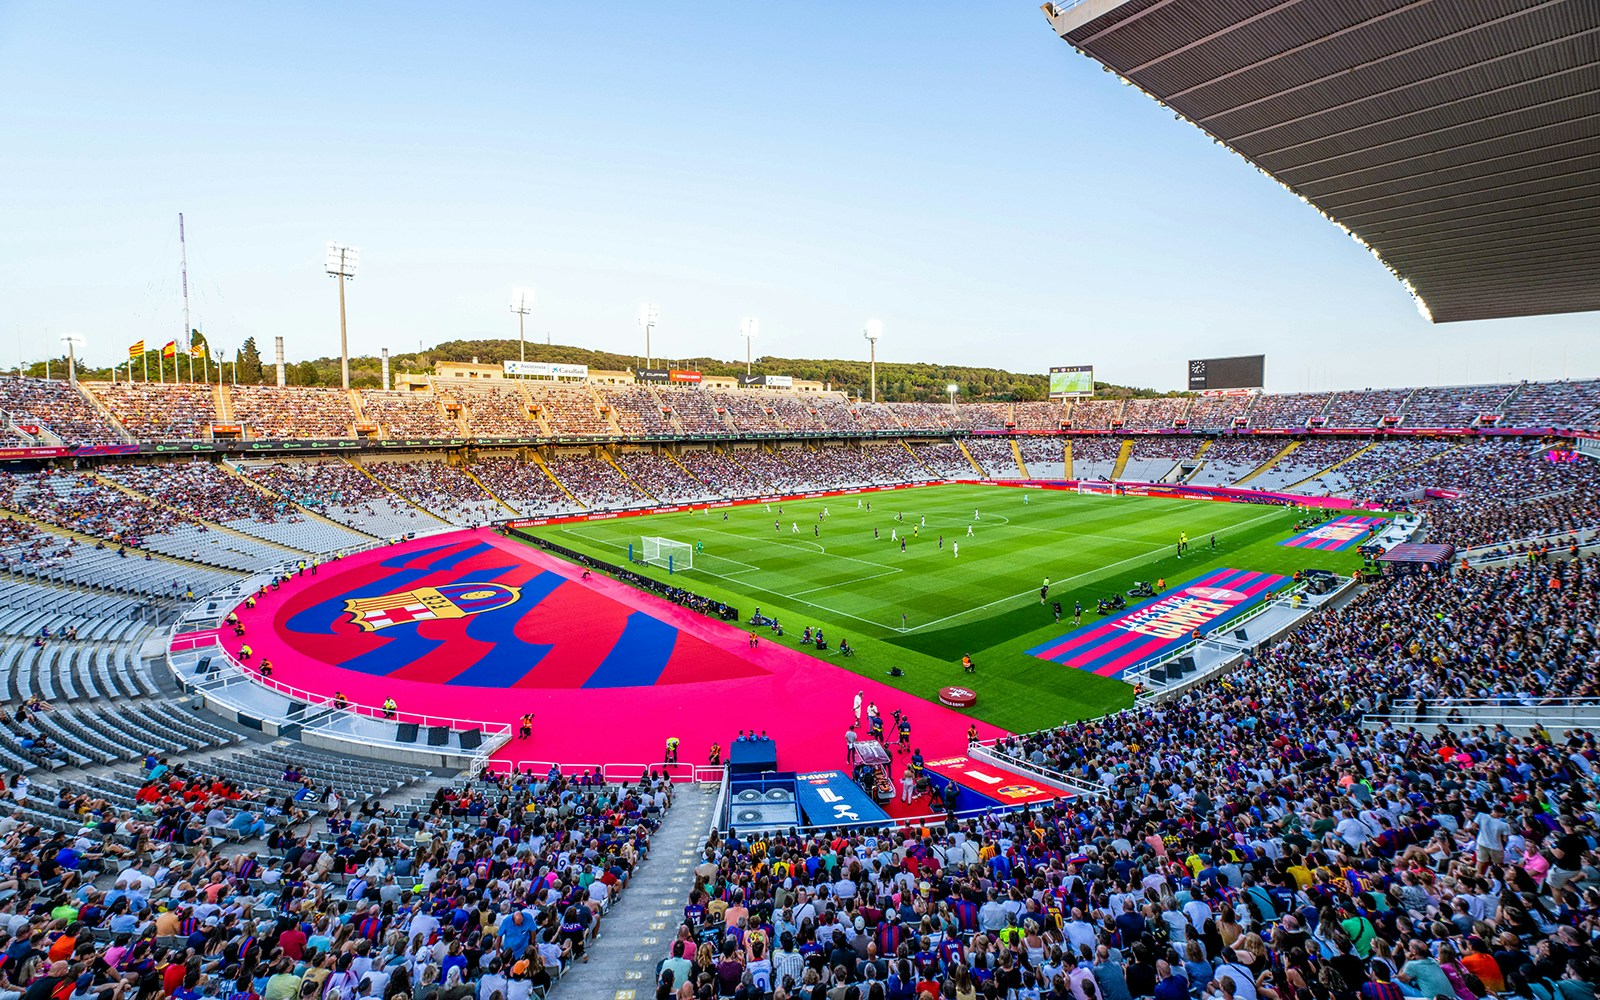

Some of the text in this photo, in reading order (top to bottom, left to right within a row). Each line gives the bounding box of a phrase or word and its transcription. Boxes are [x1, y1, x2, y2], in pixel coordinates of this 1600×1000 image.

[1134, 599, 1234, 640] GAMPER
[1283, 898, 1292, 912] 7
[714, 912, 721, 923] 8
[644, 937, 656, 945] 18
[627, 971, 642, 979] 20
[618, 991, 634, 999] 21
